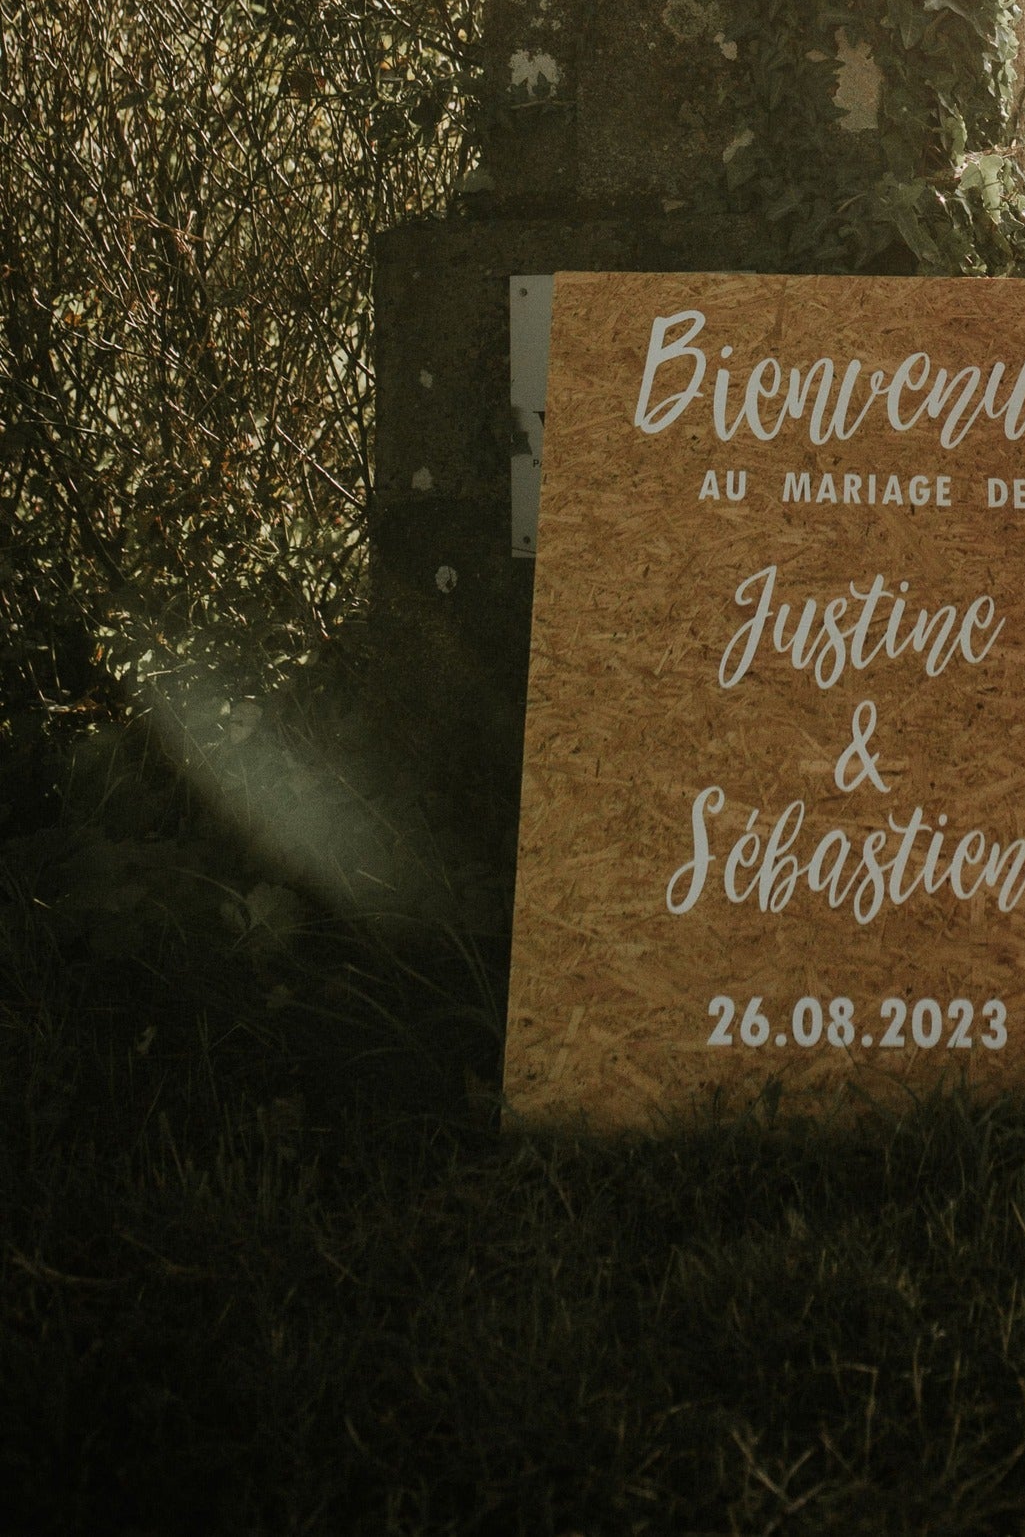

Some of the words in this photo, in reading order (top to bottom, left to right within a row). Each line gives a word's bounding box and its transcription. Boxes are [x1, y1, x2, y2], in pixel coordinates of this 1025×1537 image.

[698, 469, 747, 502] AU
[782, 472, 952, 508] MARIAGE
[718, 564, 1005, 689] Justine
[834, 699, 891, 793] &
[707, 995, 1008, 1049] 26.08.2023
